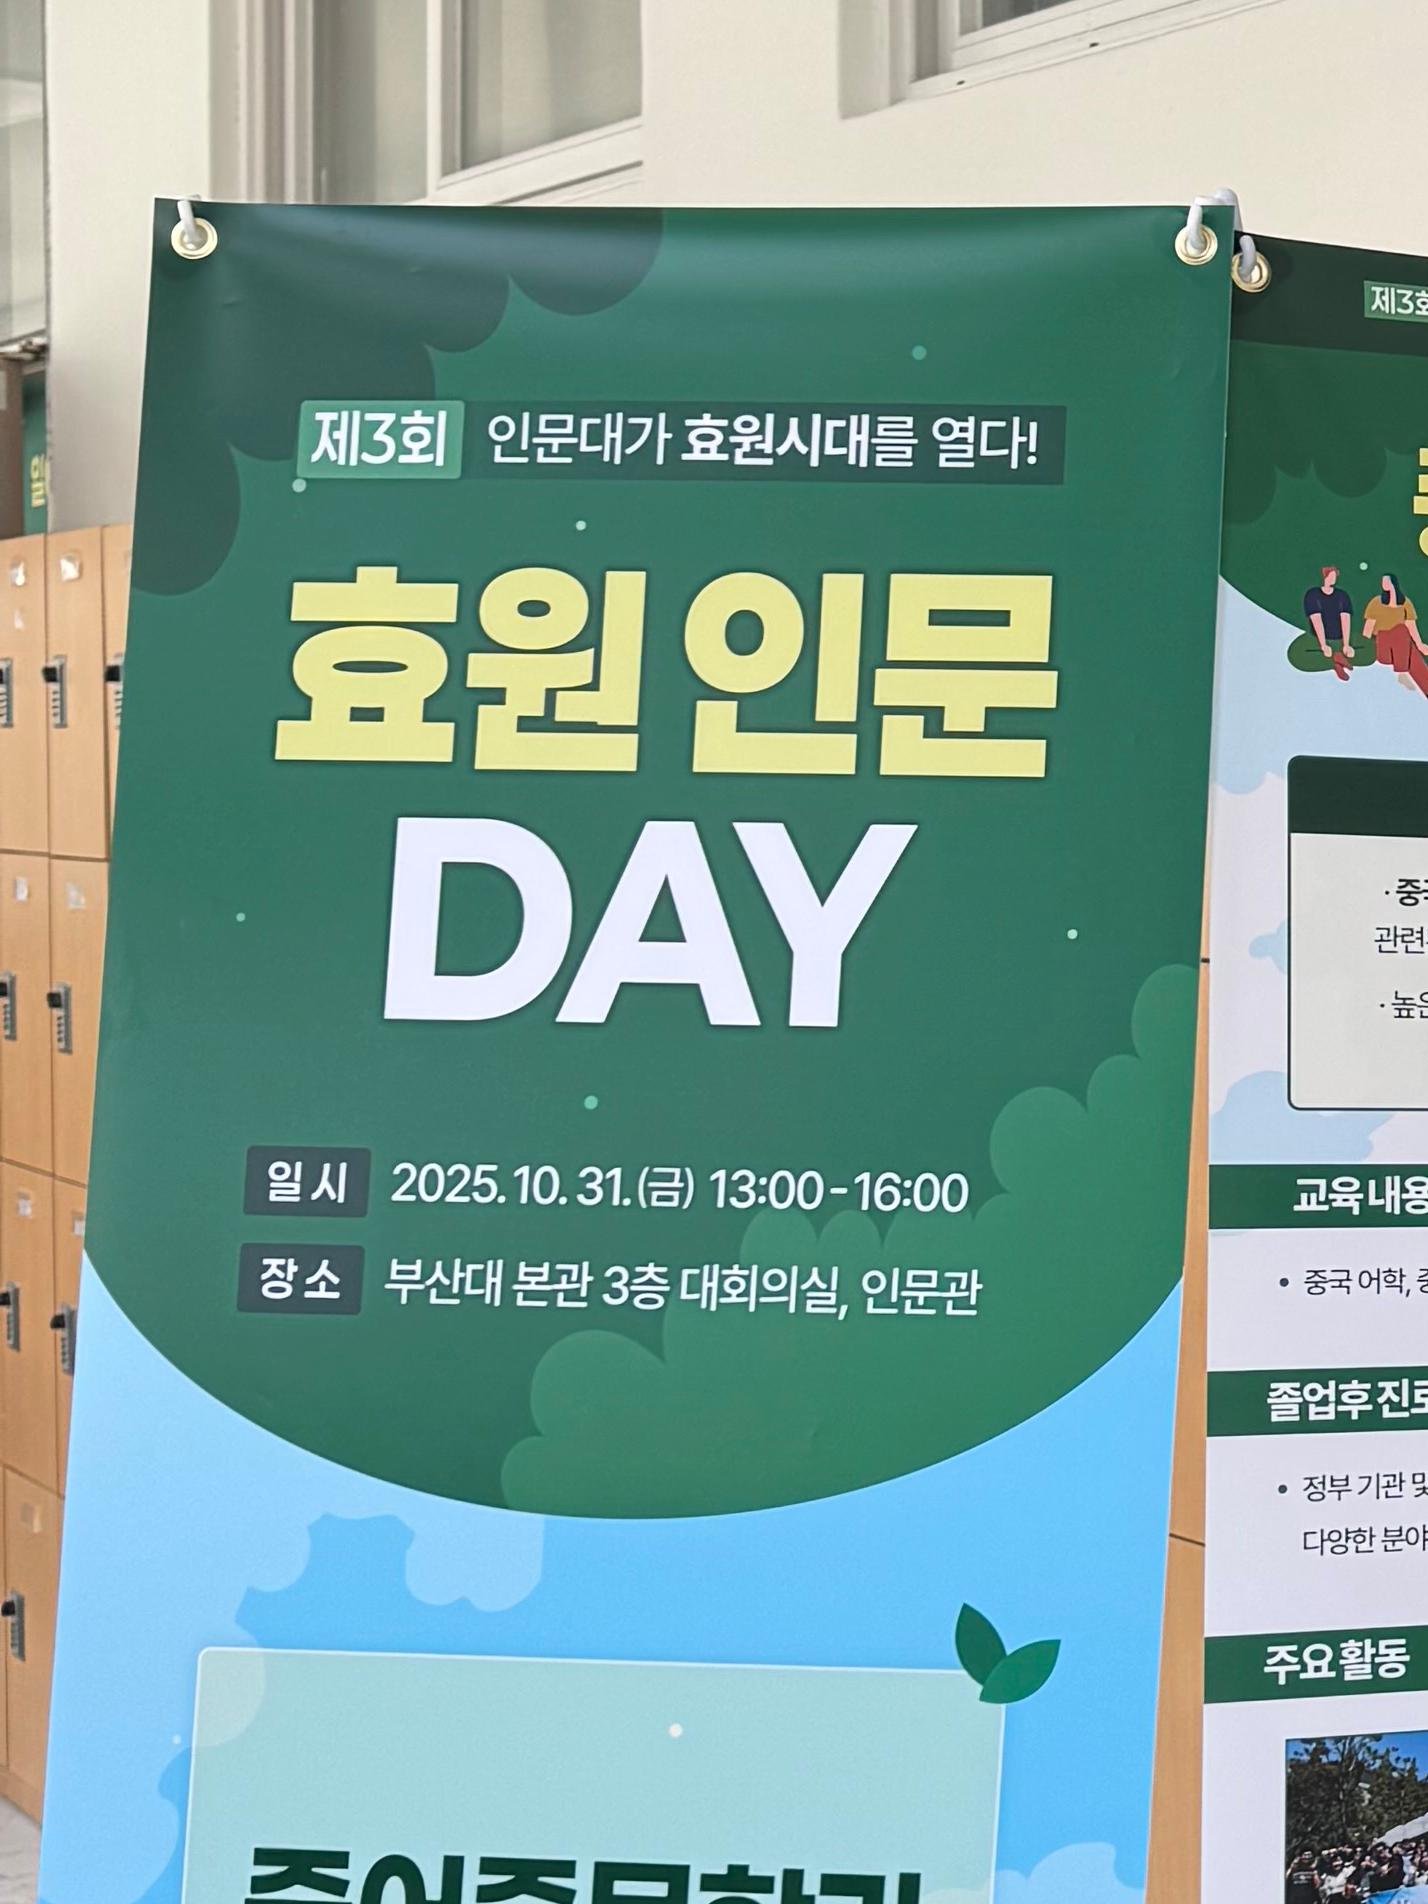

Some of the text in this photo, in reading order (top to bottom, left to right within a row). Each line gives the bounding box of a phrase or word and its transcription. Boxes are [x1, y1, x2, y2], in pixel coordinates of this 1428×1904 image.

[311, 410, 446, 466] 제3회
[489, 412, 1037, 469] 인문대가 효원시대를 열다!
[275, 567, 1058, 777] 효원 인문
[384, 817, 918, 1027] DAY
[391, 1162, 970, 1214] 2025. 10. 31.(금) 13:00-16:00
[385, 1258, 983, 1320] 부산대 본관 3층 대회의실, 인문관
[1304, 1270, 1352, 1295] 중국
[1359, 1268, 1410, 1297] 어학,
[1304, 1475, 1352, 1501] 정부
[1358, 1472, 1405, 1499] 기관
[1304, 1527, 1376, 1556] 다양한
